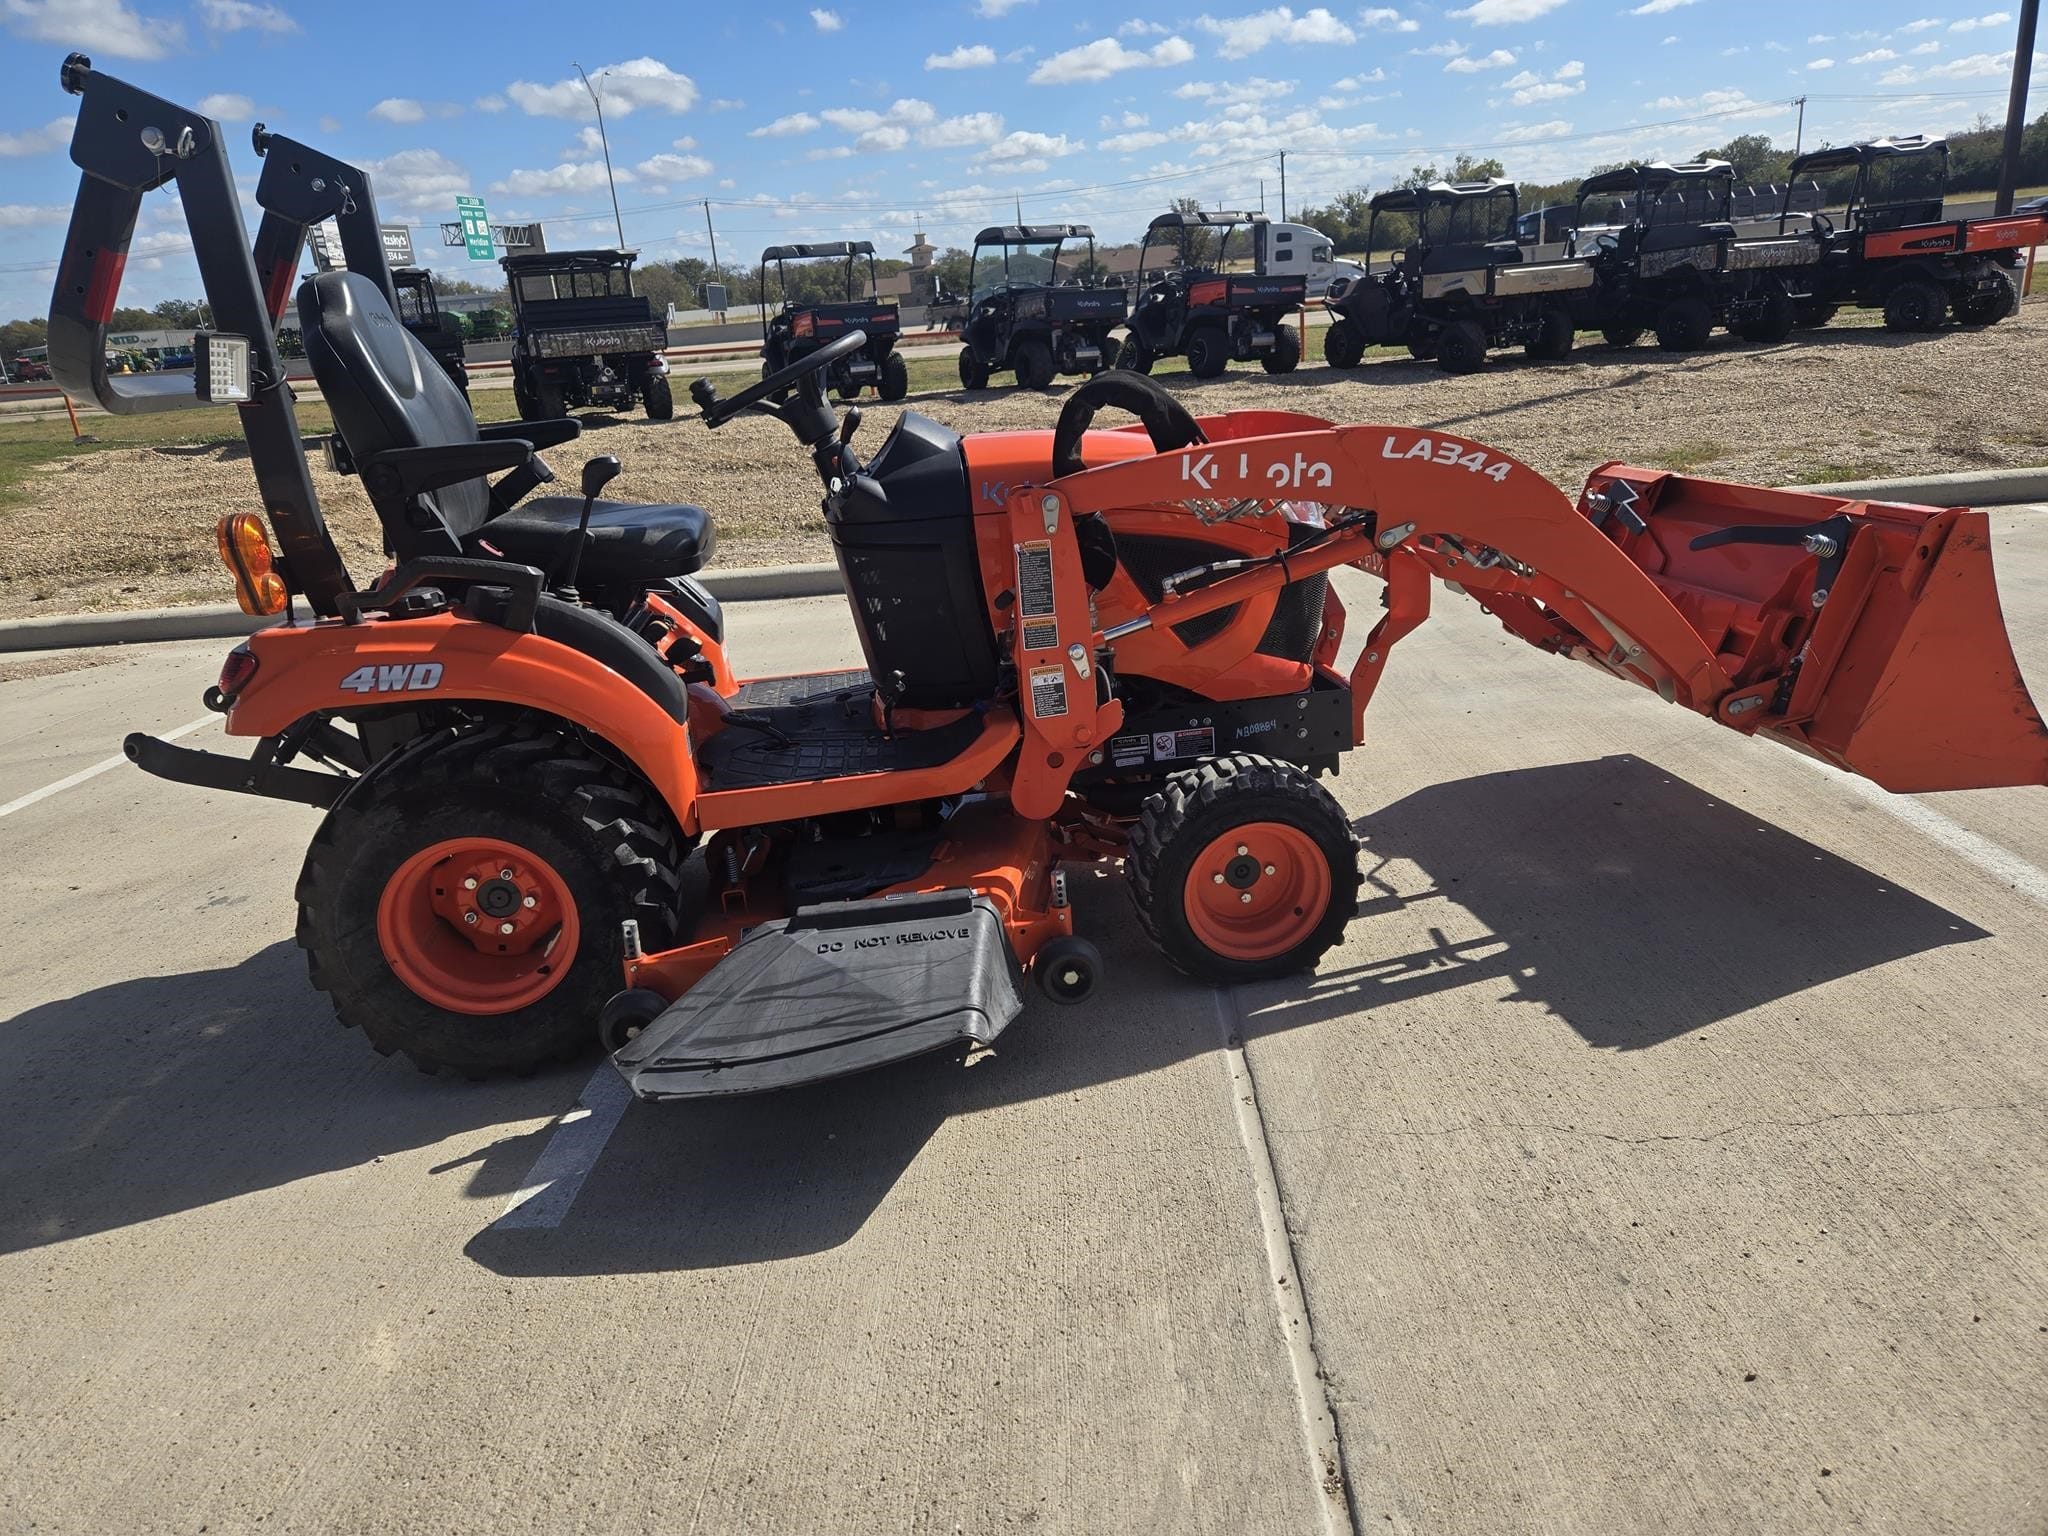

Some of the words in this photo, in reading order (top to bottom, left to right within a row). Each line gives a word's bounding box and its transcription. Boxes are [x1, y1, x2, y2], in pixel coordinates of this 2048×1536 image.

[382, 234, 407, 248] tzsky's
[470, 238, 489, 246] Meridian
[1921, 239, 1951, 248] Kubota
[1761, 249, 1786, 258] Kubota
[844, 316, 869, 324] Kubota
[107, 335, 140, 346] NITED
[586, 336, 621, 347] Kubota
[1382, 436, 1513, 482] LA344
[340, 662, 444, 693] 4WD
[817, 941, 845, 955] DO
[854, 936, 891, 950] NOT
[896, 927, 971, 945] REMOVE
